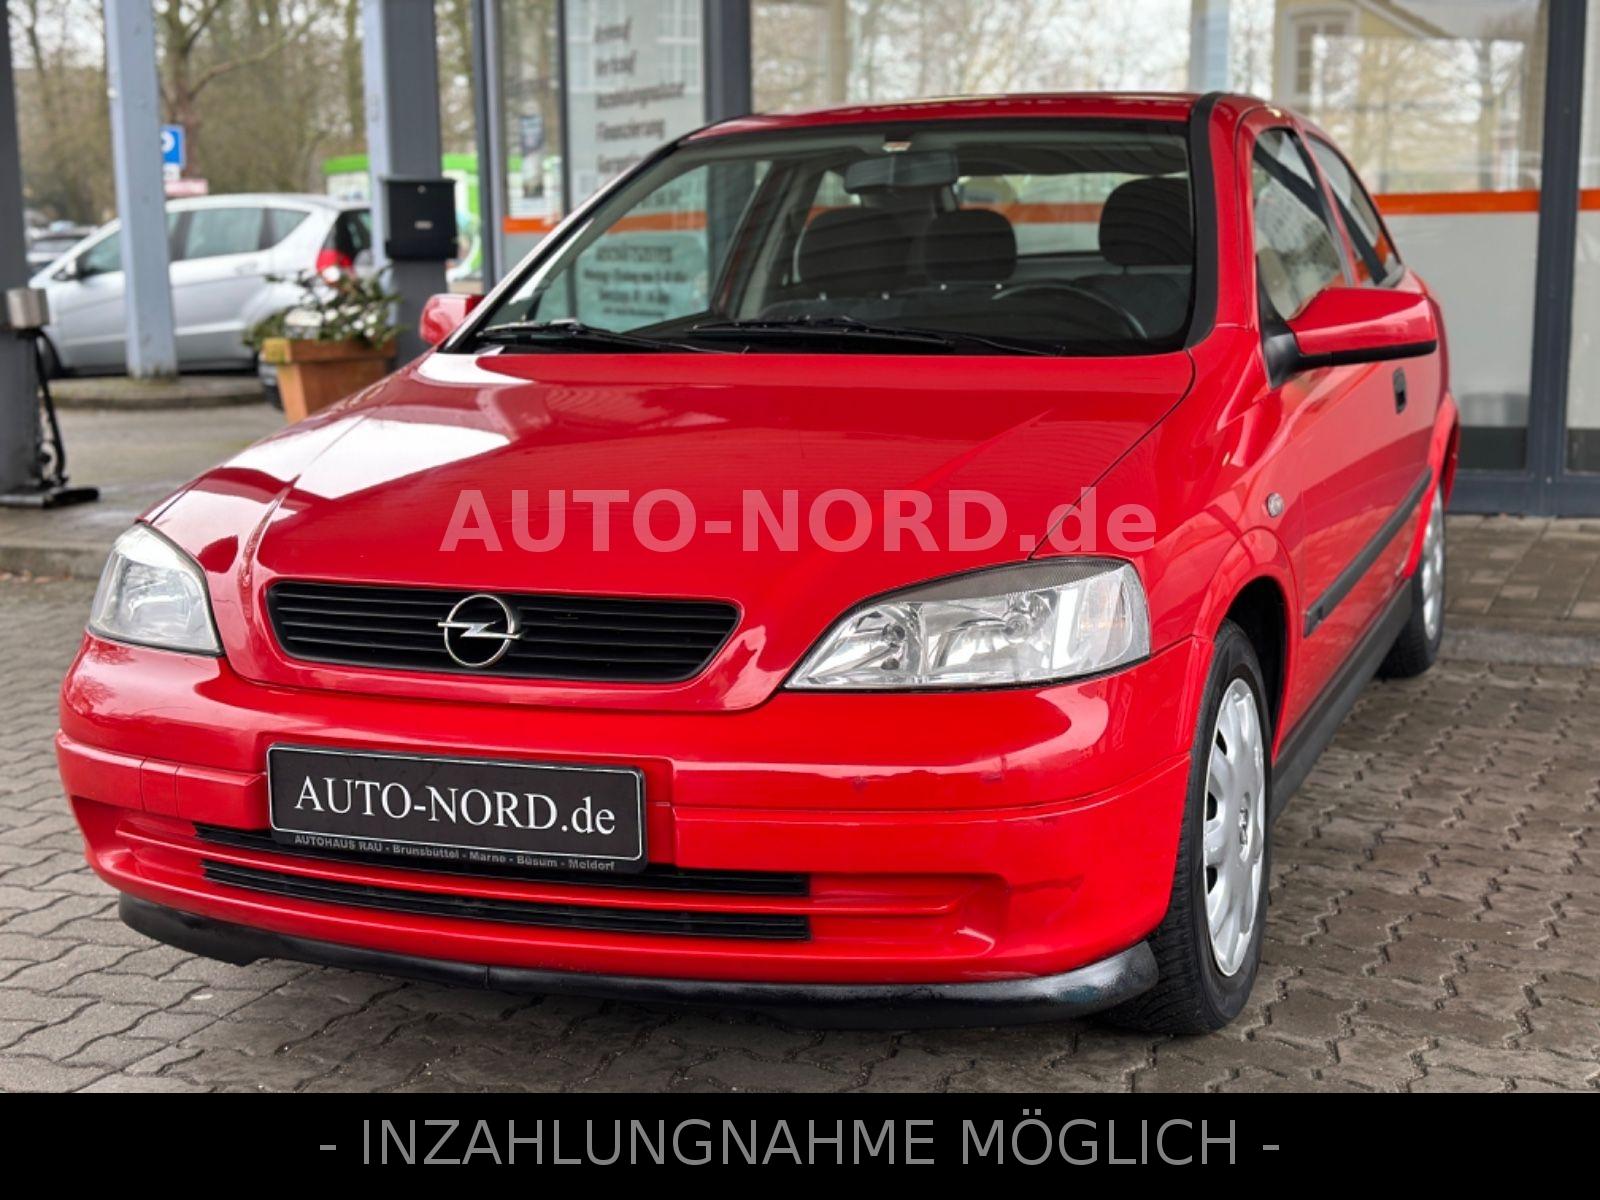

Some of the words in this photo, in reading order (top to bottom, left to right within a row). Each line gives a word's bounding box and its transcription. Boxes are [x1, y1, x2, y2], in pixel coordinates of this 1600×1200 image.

[294, 774, 616, 836] AUTO-NORD.de
[294, 834, 356, 850] AUTOHAUS
[358, 840, 382, 852] RAU
[516, 855, 558, 867] Büsum
